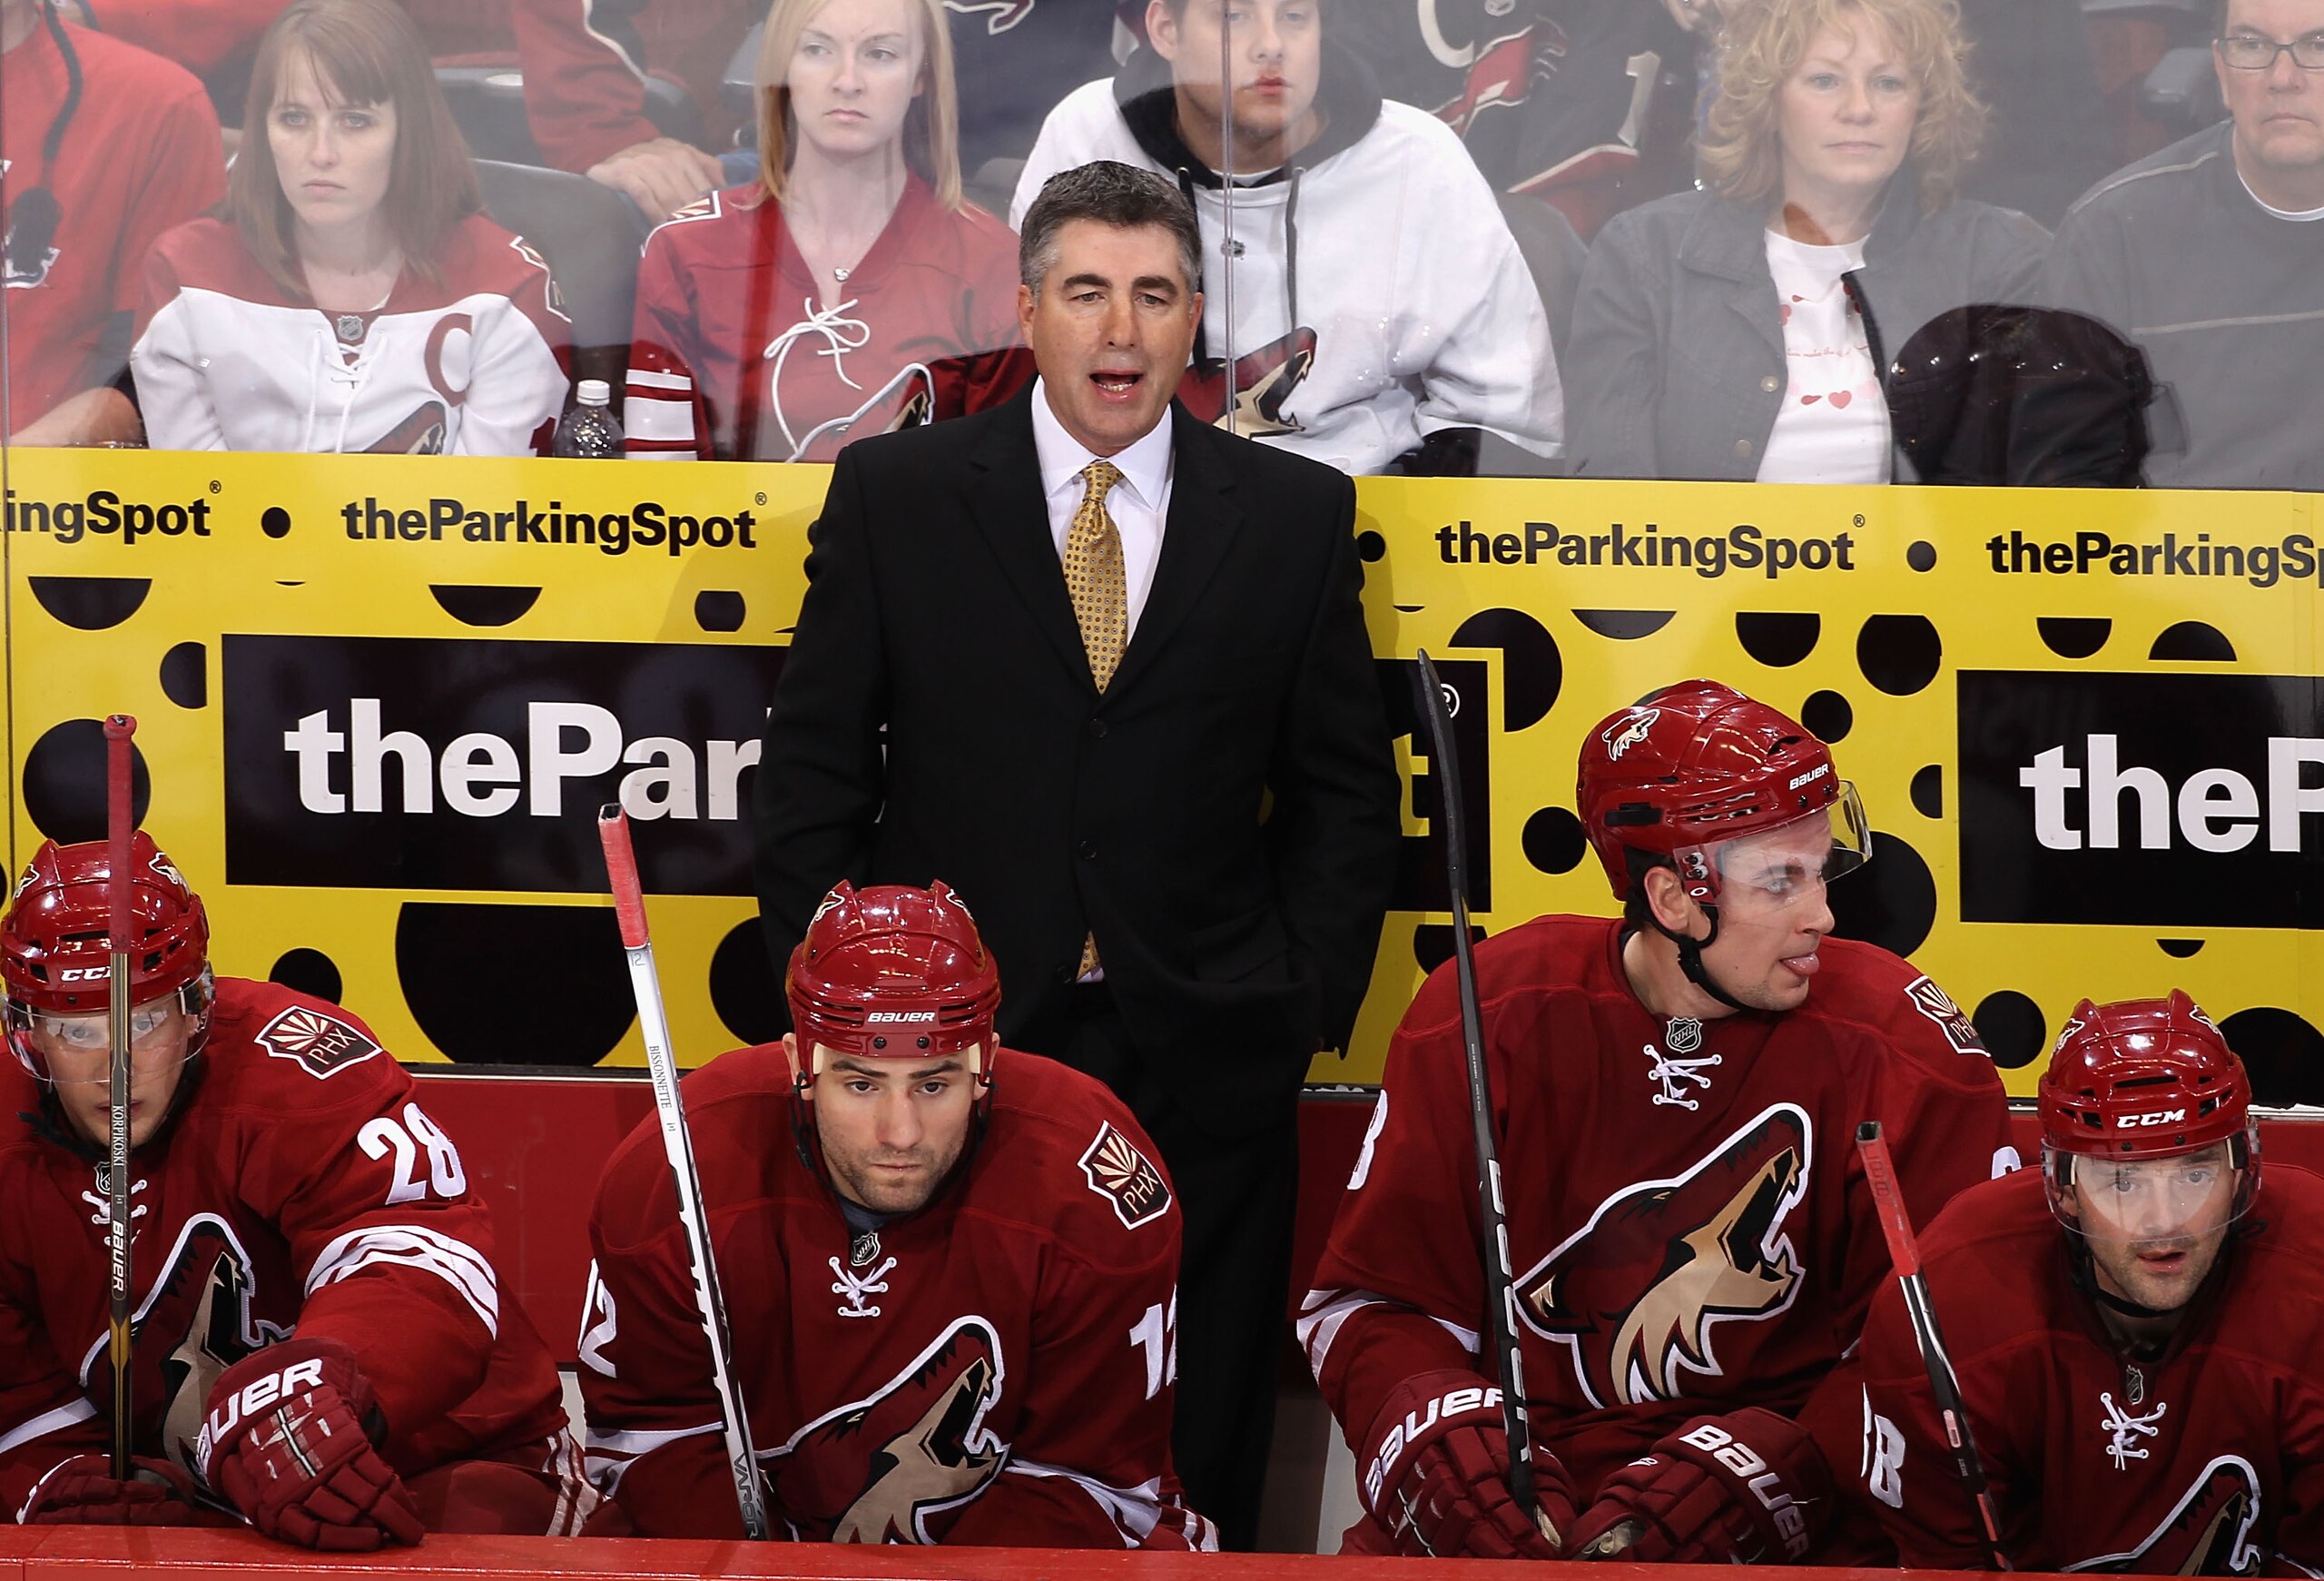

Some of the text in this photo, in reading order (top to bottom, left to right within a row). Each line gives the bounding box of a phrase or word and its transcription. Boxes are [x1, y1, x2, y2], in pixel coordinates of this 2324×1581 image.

[424, 311, 473, 408] C
[1, 490, 211, 545] ingSpot
[340, 497, 757, 557] theParkingSpot
[1434, 520, 1856, 579] theParkingSpot
[1985, 530, 2324, 588] theParkingS
[284, 698, 763, 822] thePar
[61, 966, 112, 982] CC
[308, 1027, 358, 1066] PHX
[648, 1045, 673, 1110] BISSONNETTE
[113, 1105, 124, 1166] KORPIKOSKI
[2116, 1108, 2186, 1129] CCM
[357, 1102, 468, 1205] 28
[1122, 1165, 1159, 1215] PHX
